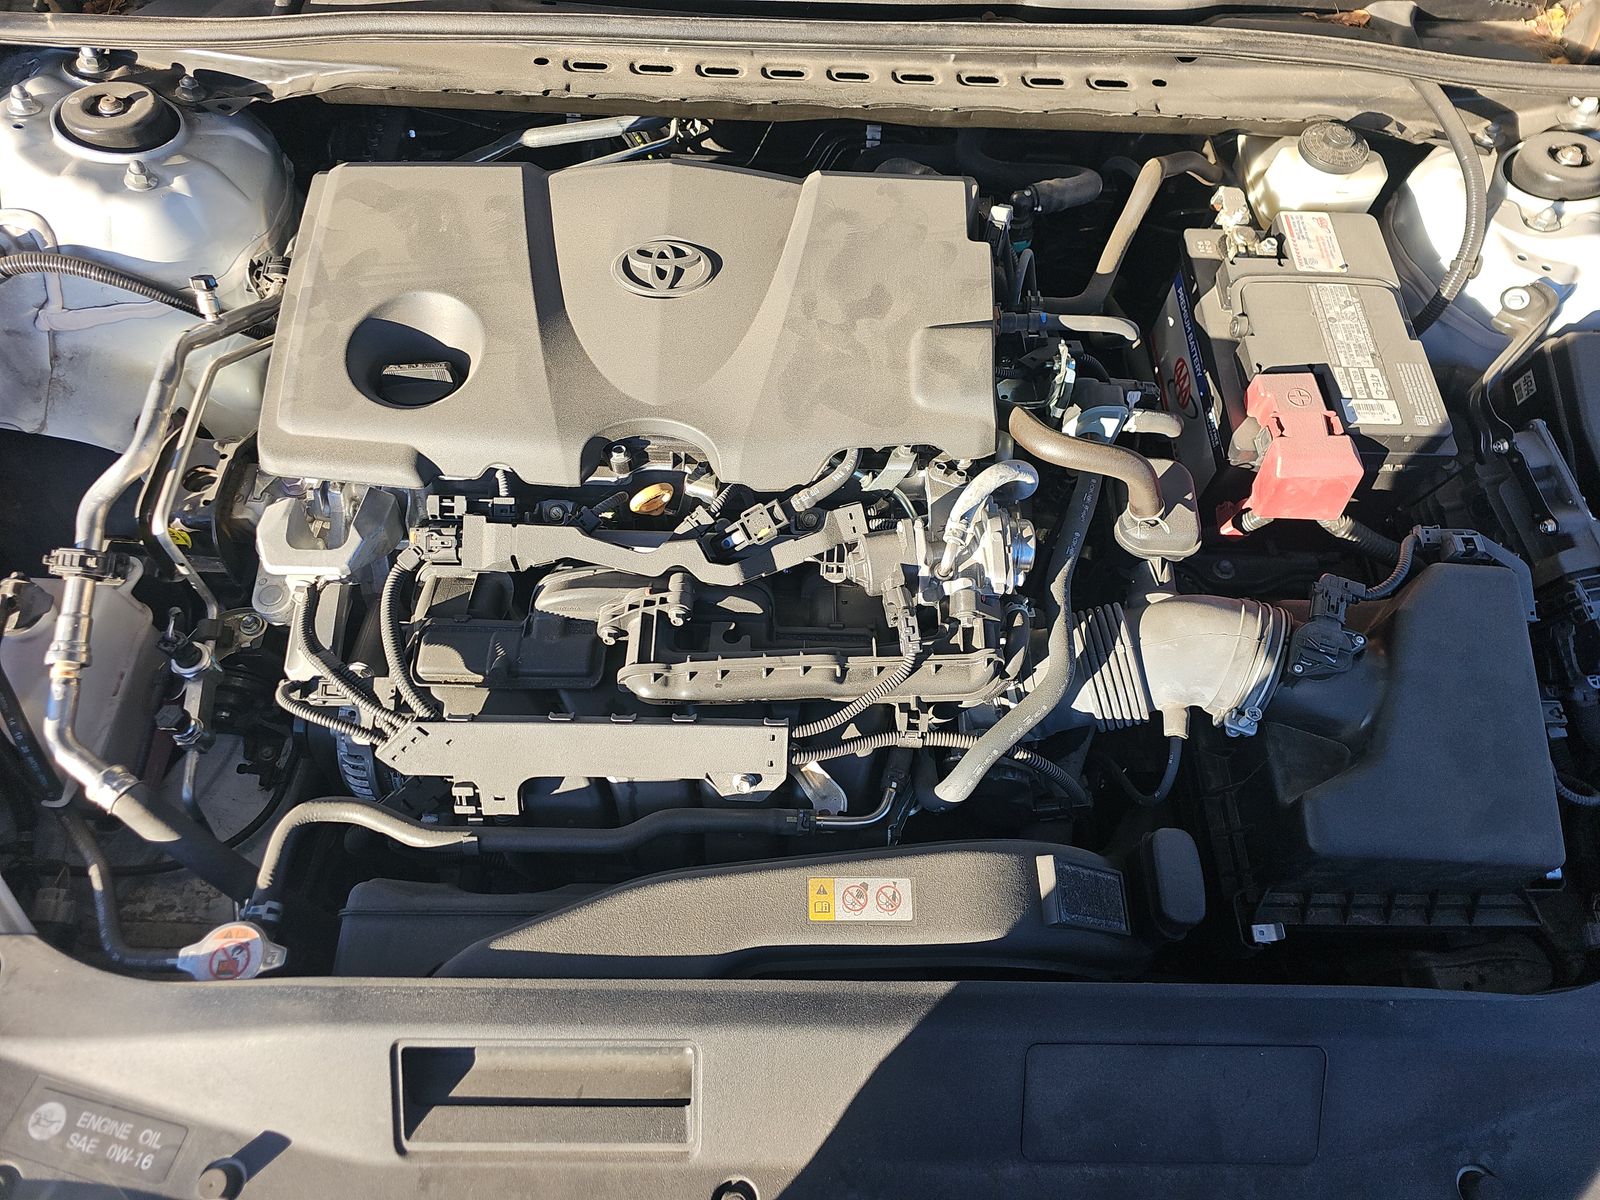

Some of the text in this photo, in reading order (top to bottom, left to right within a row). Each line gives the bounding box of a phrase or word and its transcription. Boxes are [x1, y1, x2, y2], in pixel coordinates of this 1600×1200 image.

[1177, 286, 1203, 377] PREMIUM BATTERY
[1175, 360, 1190, 408] AAA
[66, 1132, 155, 1170] SAE 0W-16
[76, 1111, 162, 1149] ENGINE OIL
